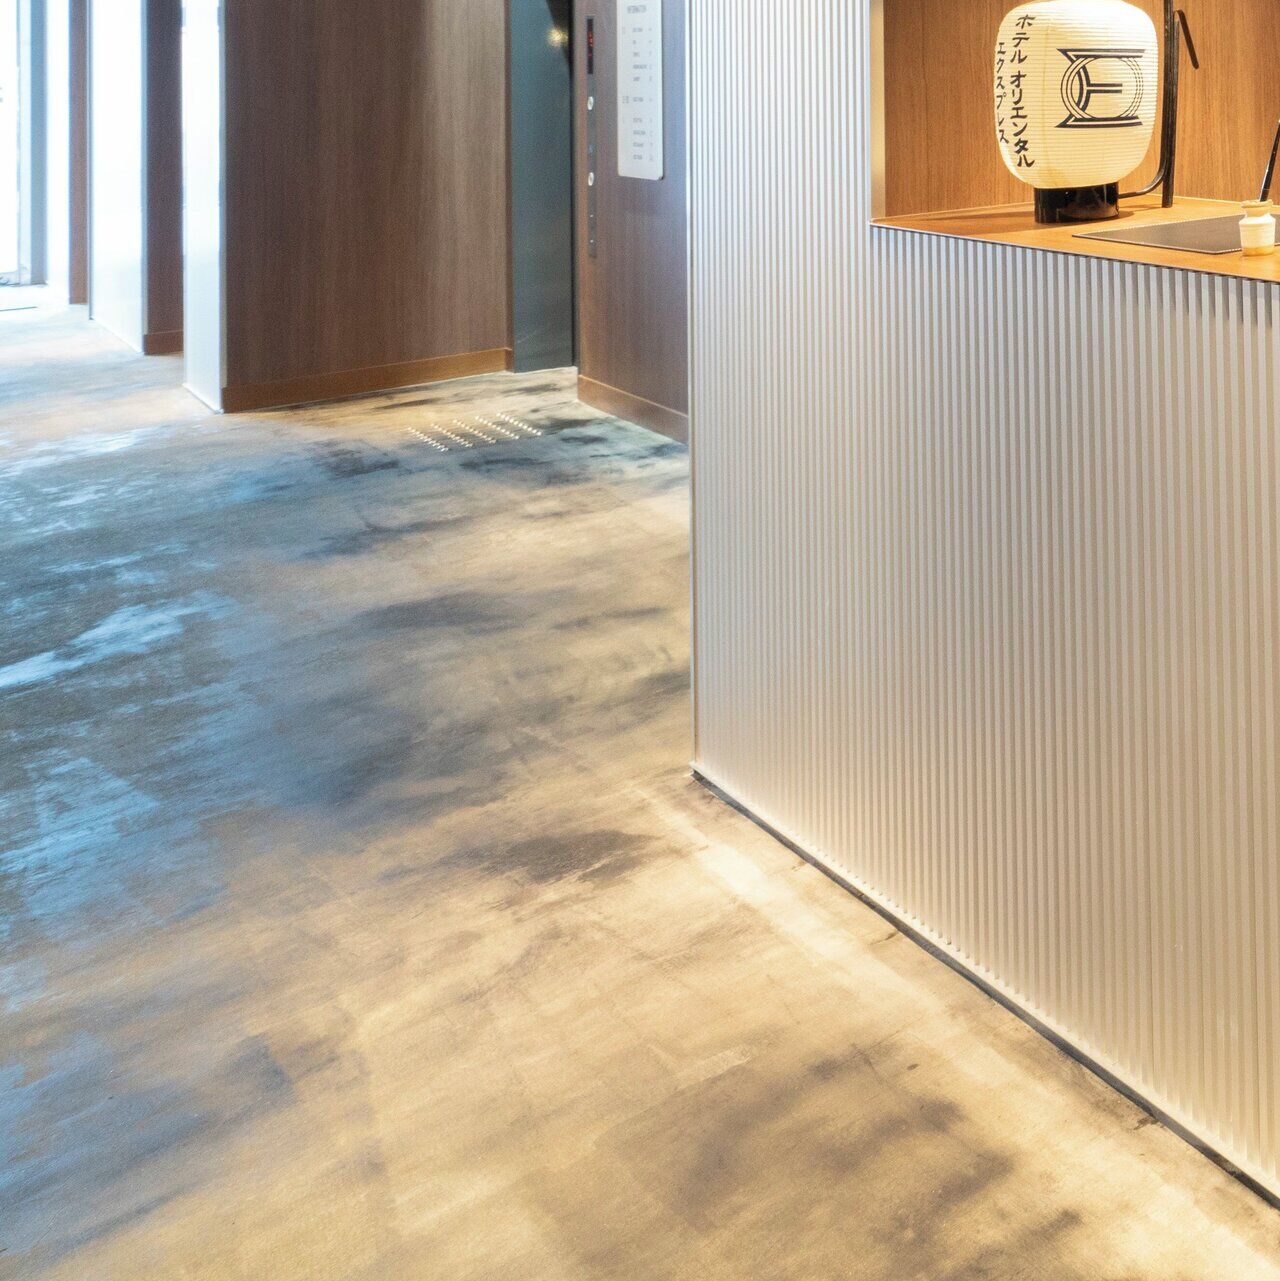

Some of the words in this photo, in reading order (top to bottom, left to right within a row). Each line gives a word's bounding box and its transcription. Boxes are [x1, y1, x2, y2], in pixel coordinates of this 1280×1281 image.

[996, 42, 1009, 144] エクスプレス
